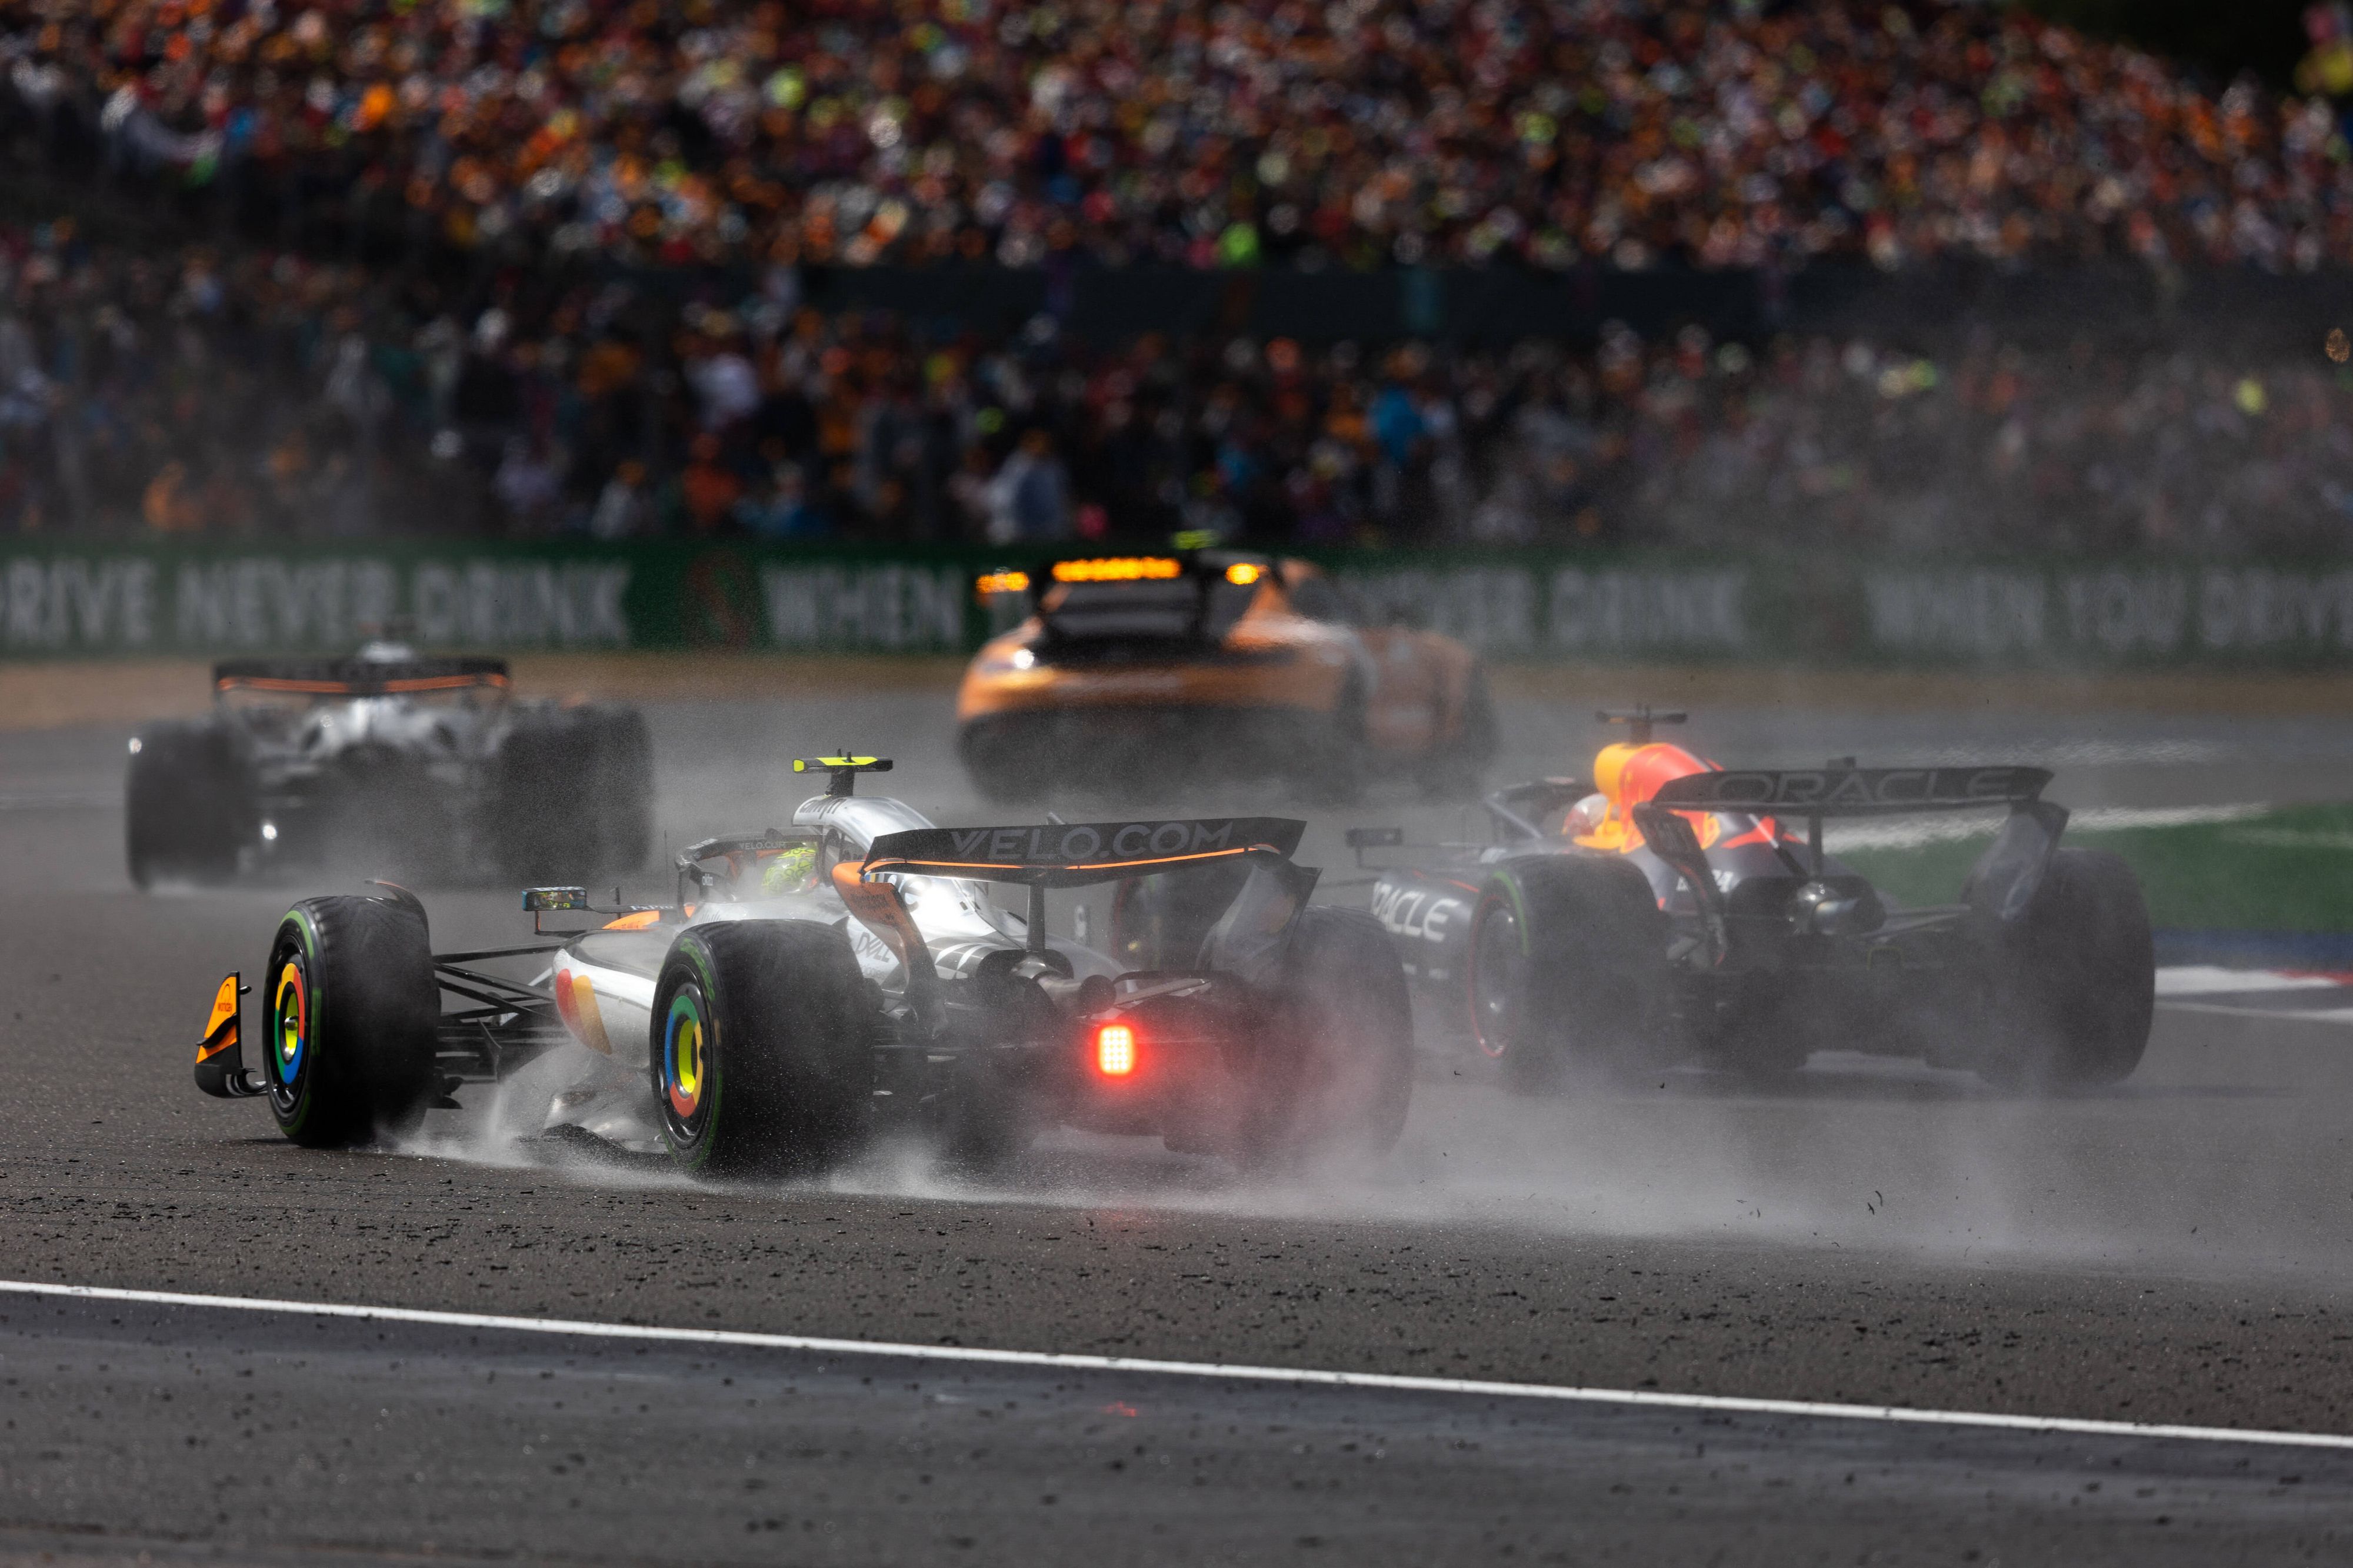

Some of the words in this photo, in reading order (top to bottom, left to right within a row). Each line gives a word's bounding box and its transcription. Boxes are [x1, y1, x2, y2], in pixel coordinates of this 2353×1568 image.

[0, 558, 157, 646] RIVE
[1714, 768, 2017, 802] ORACLE
[949, 822, 1234, 860] VELO.COM
[855, 931, 890, 963] DELL
